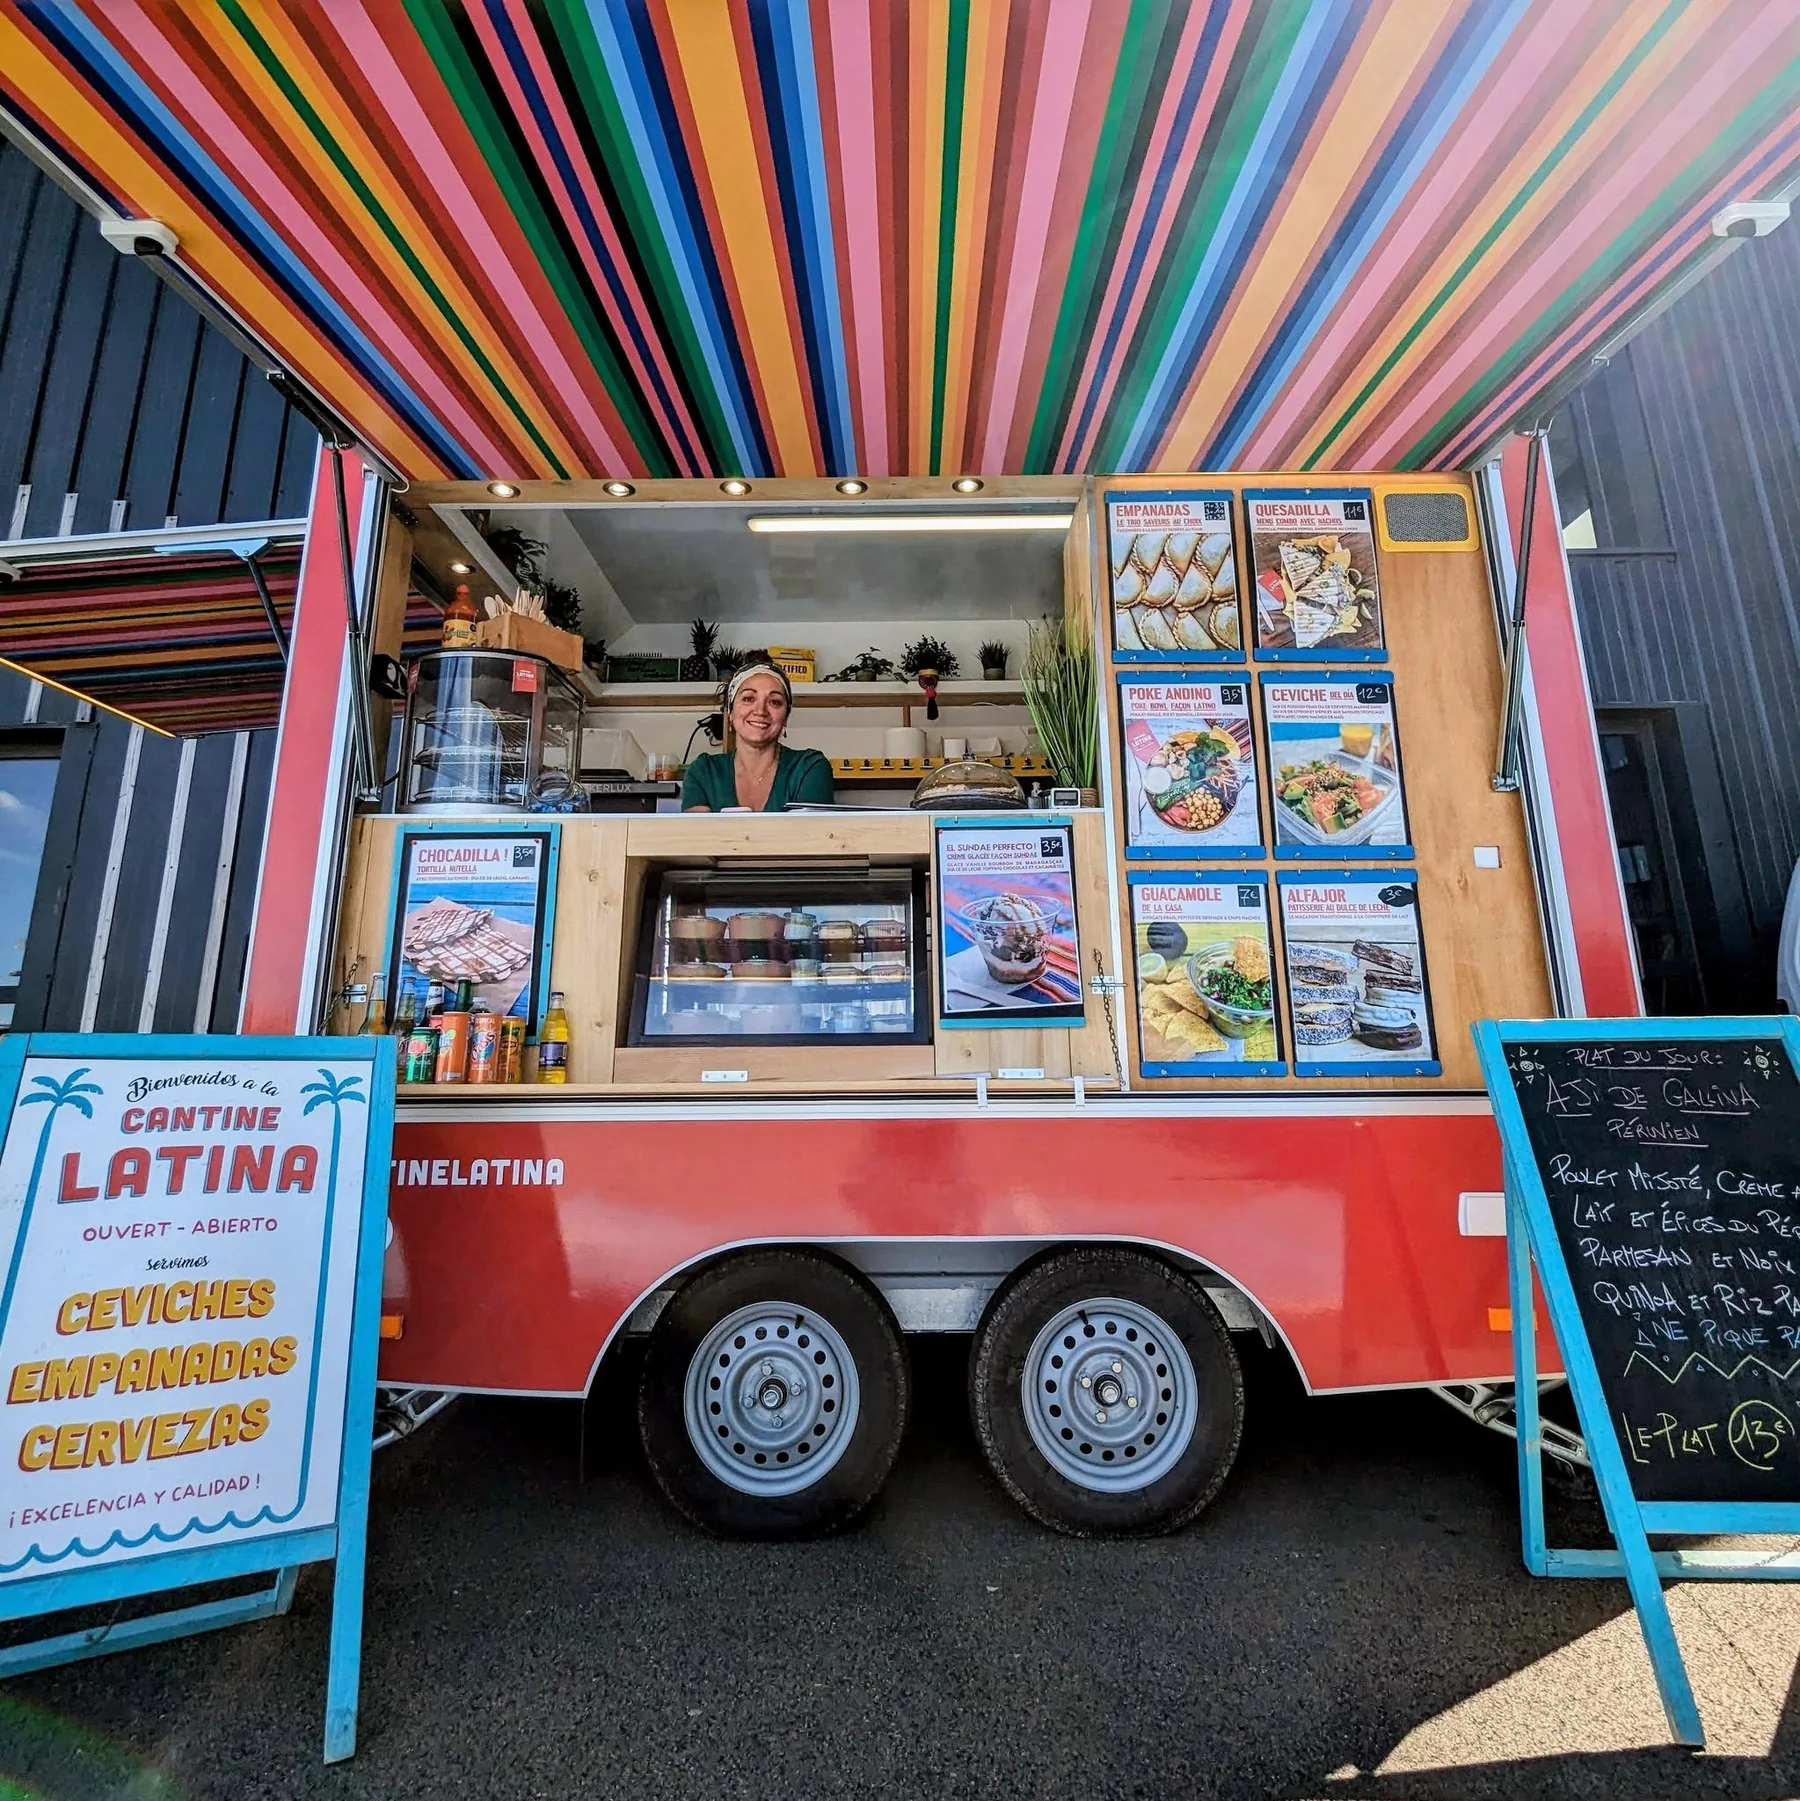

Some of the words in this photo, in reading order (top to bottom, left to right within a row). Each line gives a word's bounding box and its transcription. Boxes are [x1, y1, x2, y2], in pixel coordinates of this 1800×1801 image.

[1116, 504, 1190, 517] EMPANADAS
[1255, 504, 1331, 517] QUESADILLA
[779, 664, 807, 674] CIFICO
[1129, 687, 1161, 700] POKE
[1165, 687, 1212, 700] ANDINO
[1272, 688, 1327, 702] CEVICHE
[1150, 702, 1167, 710] BOWL
[1171, 702, 1191, 711] FAÇON
[1194, 702, 1216, 710] LATINO
[586, 783, 631, 793] KERLUX
[418, 848, 500, 862] CHOCADILLA
[417, 865, 446, 873] TORTILLA
[1141, 887, 1222, 902] GUACAMOLE
[1287, 888, 1347, 902] ALFAJOR
[1336, 903, 1358, 911] DULCE
[1369, 903, 1391, 911] LECHE
[1567, 1048, 1615, 1066] PLAT
[1624, 1051, 1652, 1064] DU
[126, 1070, 240, 1102] Bienvenidos
[242, 1080, 257, 1091] a
[260, 1079, 281, 1097] la
[1608, 1086, 1648, 1107] DE
[120, 1105, 282, 1135] CANTINE
[56, 1144, 319, 1205] LATINA
[390, 1158, 565, 1186] INELATINA
[1550, 1154, 1618, 1187] POULET
[1716, 1170, 1785, 1198] CRÈME
[82, 1221, 172, 1243] OUVERT
[192, 1217, 278, 1236] ABIERTO
[1630, 1211, 1655, 1228] ET
[1727, 1219, 1759, 1234] DU
[1579, 1237, 1692, 1268] PARMESAN
[1712, 1252, 1733, 1268] ET
[146, 1254, 210, 1272] servimos
[55, 1278, 276, 1336] CEVICHES
[1687, 1294, 1710, 1310] ET
[1773, 1285, 1800, 1317] PA
[1652, 1317, 1688, 1341] NE
[1699, 1319, 1770, 1350] PIQUE
[1777, 1326, 1800, 1349] PA
[9, 1335, 299, 1404] EMPANADAS
[17, 1398, 272, 1472] CERVEZAS
[1622, 1412, 1652, 1464] LE
[1653, 1412, 1718, 1458] PLAT
[154, 1490, 167, 1504] Y
